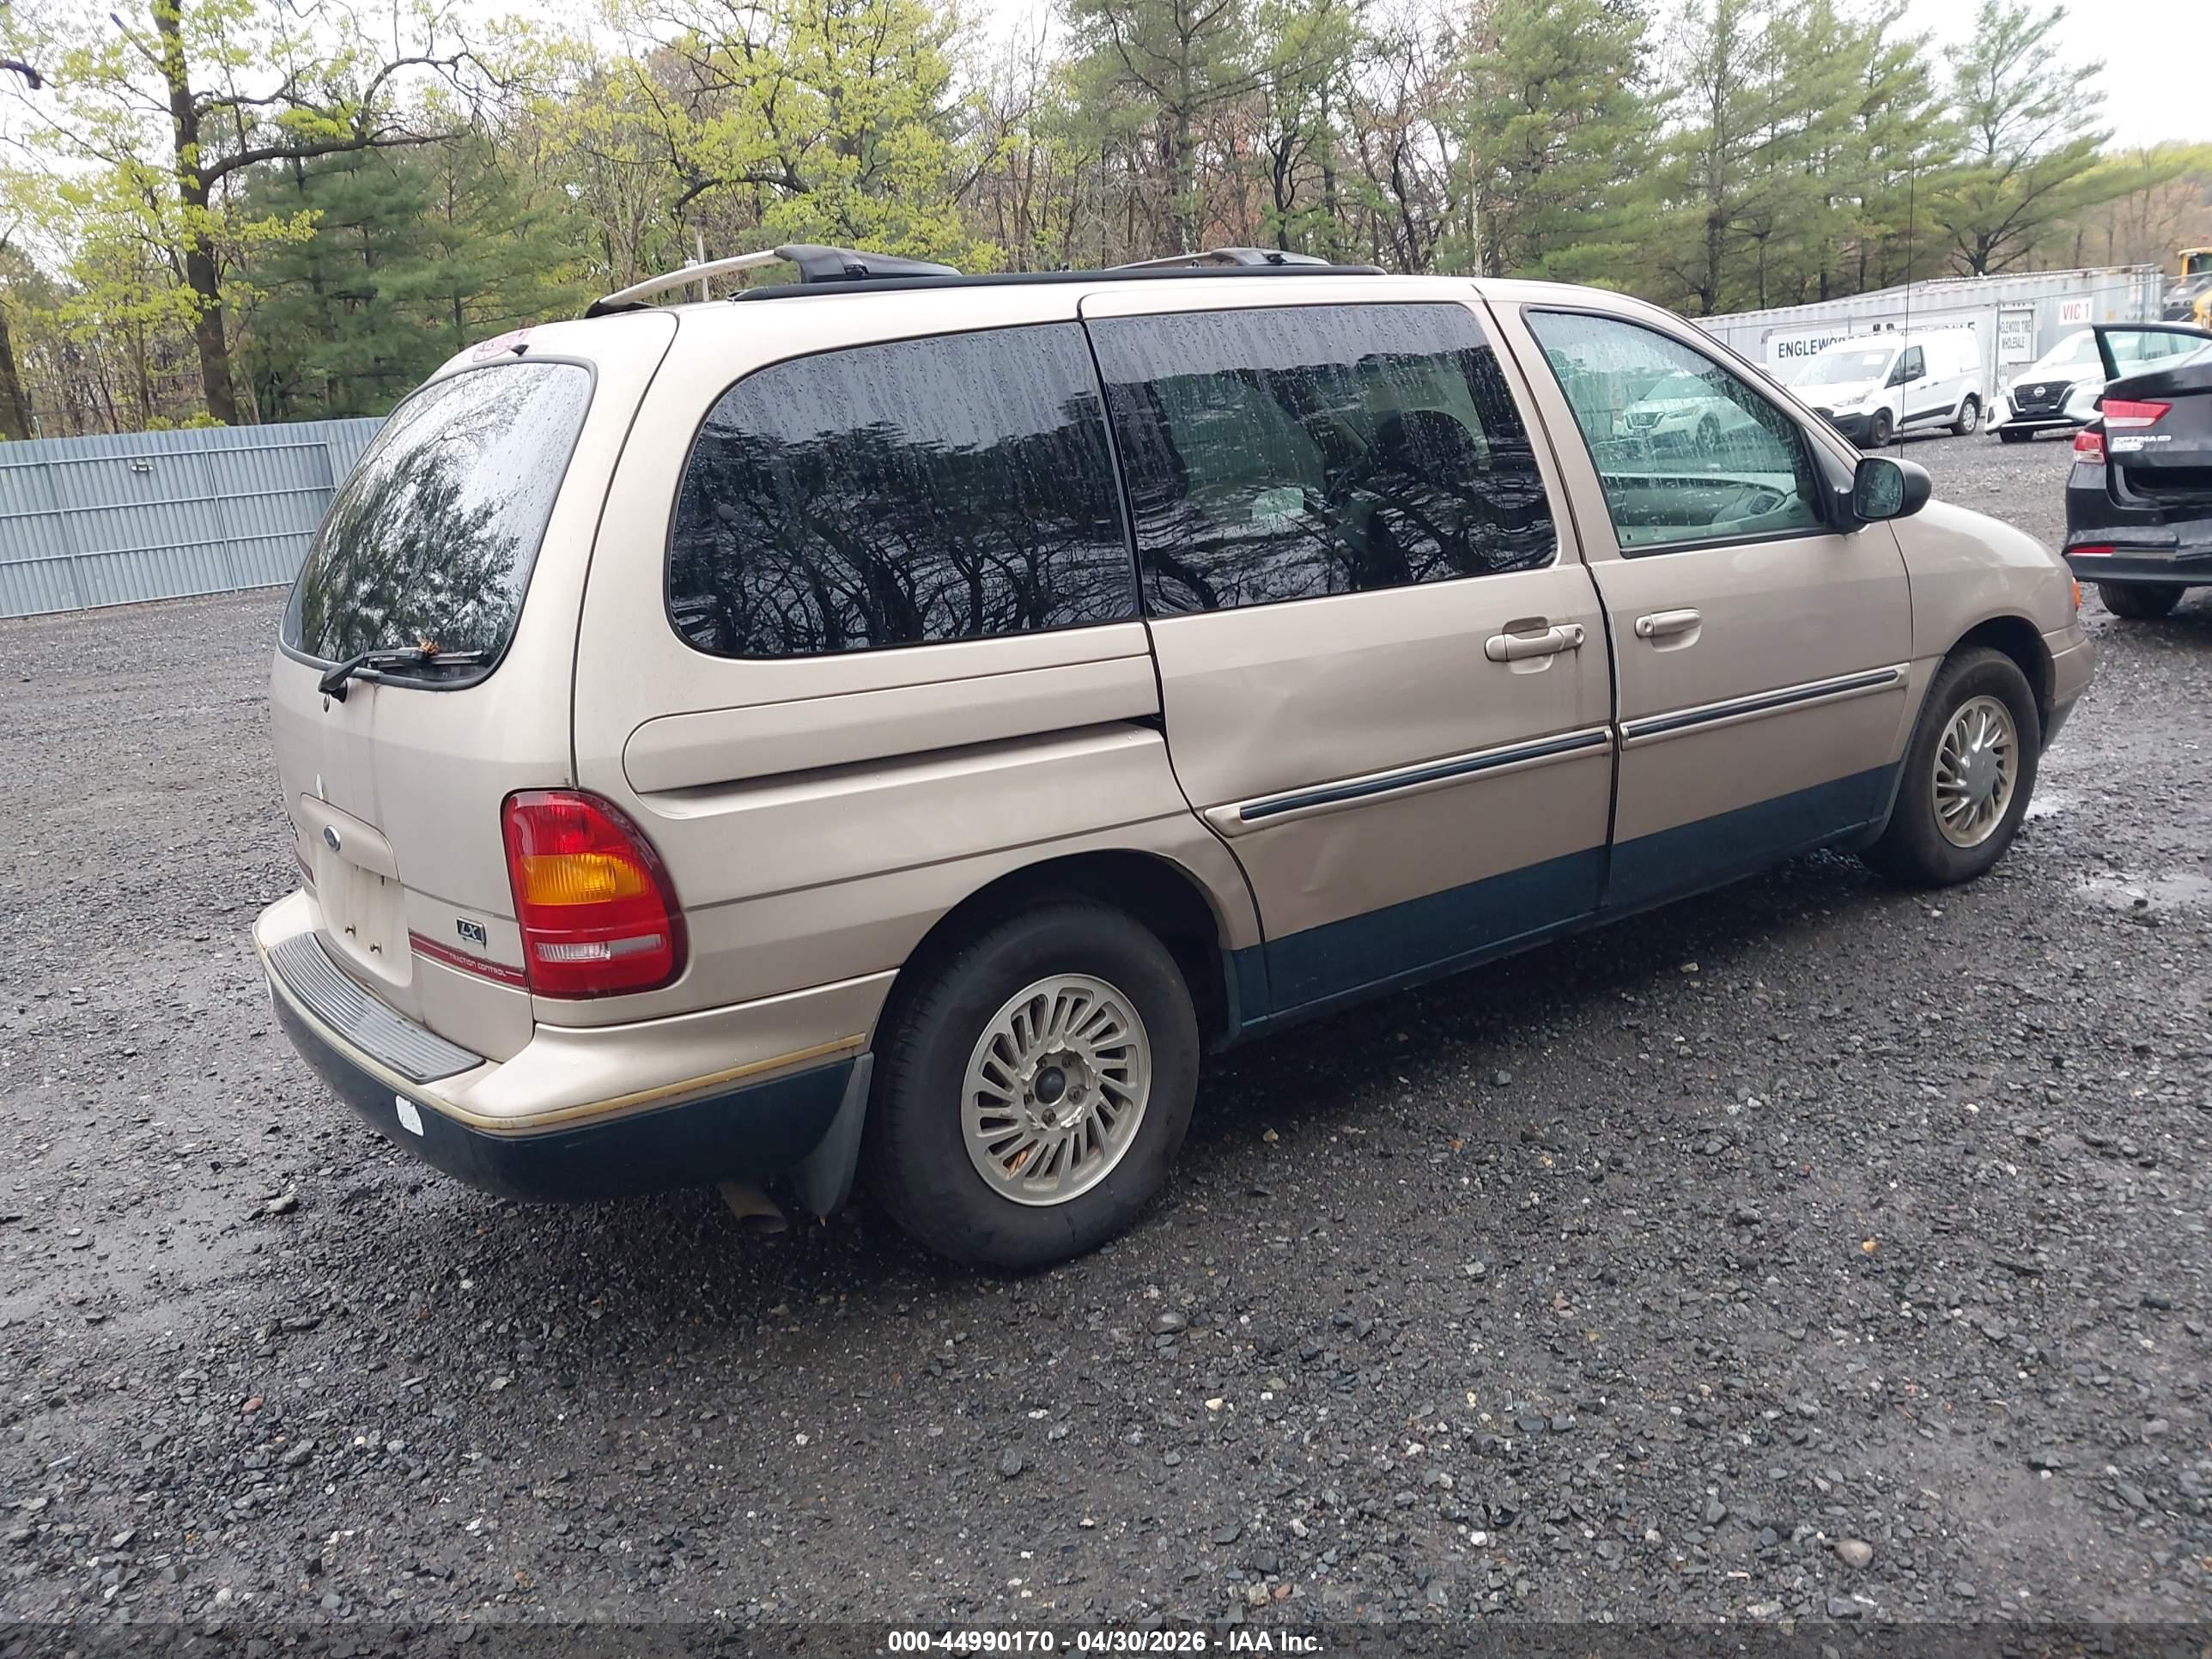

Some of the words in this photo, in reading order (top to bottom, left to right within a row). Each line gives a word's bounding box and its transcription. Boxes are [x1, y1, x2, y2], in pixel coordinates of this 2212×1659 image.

[2063, 303, 2081, 320] VIC
[2085, 302, 2089, 319] 1
[460, 922, 478, 939] LX
[449, 952, 477, 969] TRACTION
[477, 962, 507, 977] CONTROL
